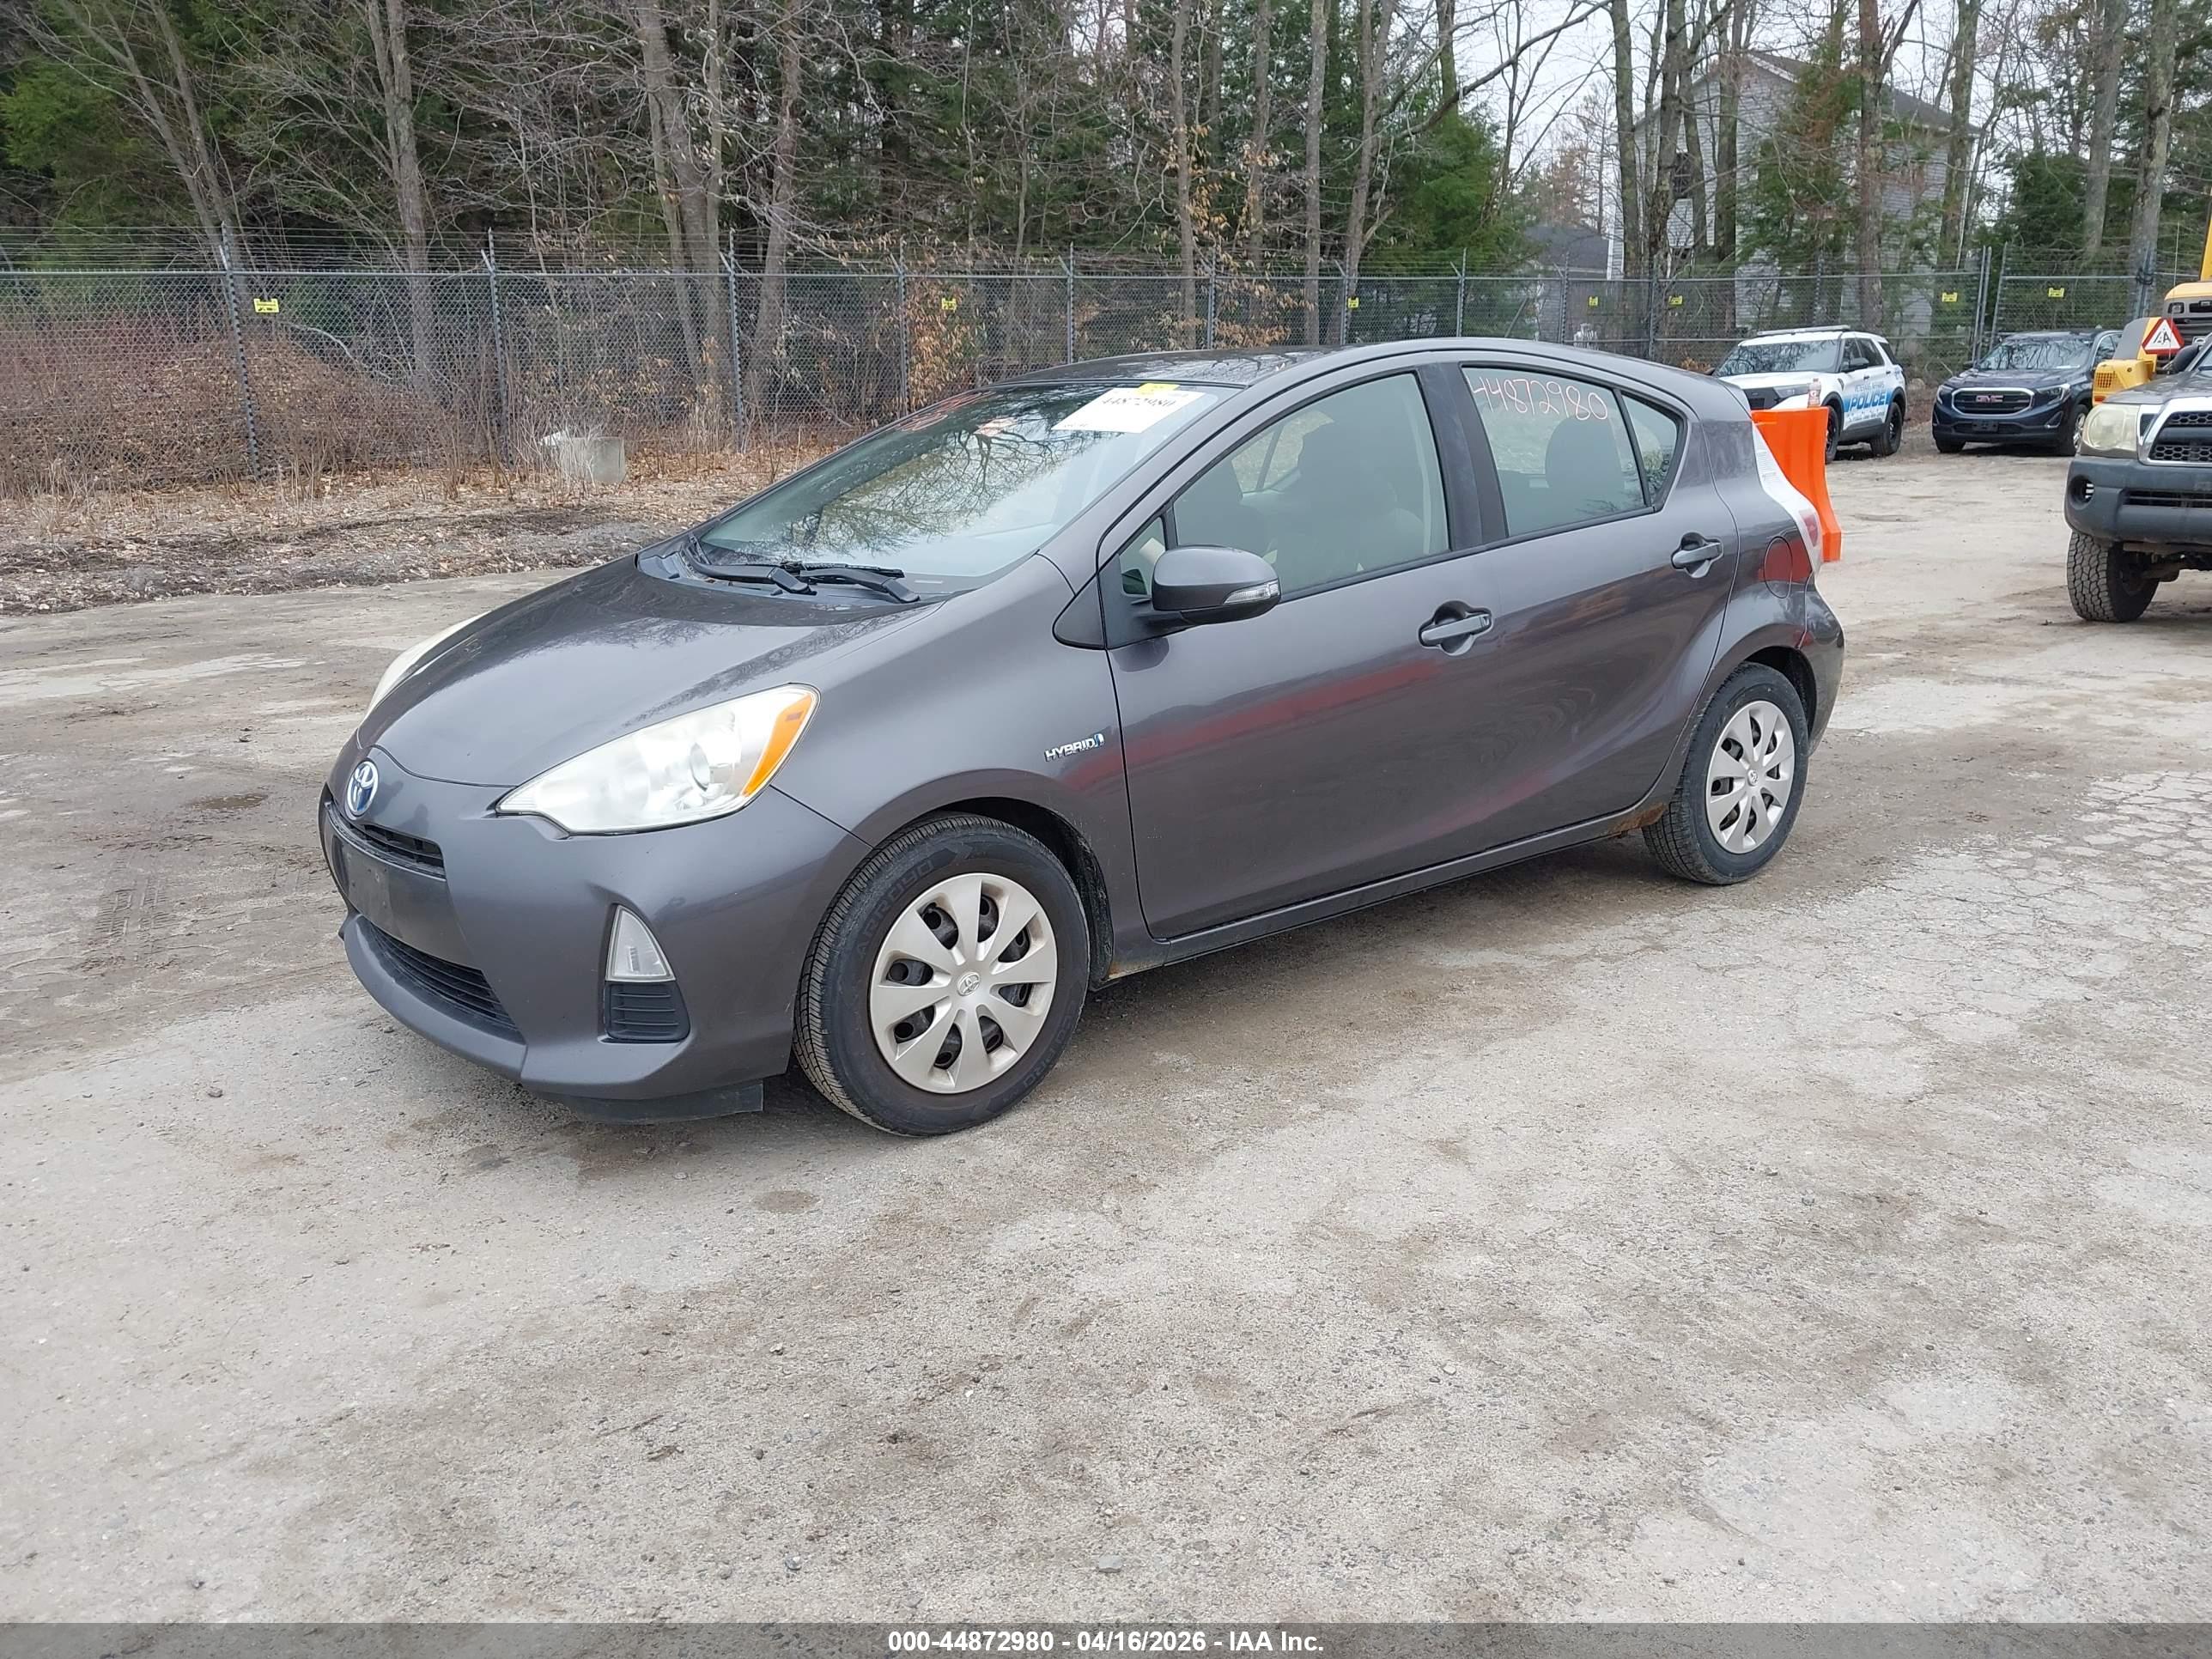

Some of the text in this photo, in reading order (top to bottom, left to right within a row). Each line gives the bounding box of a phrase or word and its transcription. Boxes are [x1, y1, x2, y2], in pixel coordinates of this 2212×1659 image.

[1465, 375, 1608, 421] 44872980
[1850, 392, 1887, 411] POLICE
[1976, 395, 2004, 404] GMC
[1044, 736, 1096, 762] HYBRID
